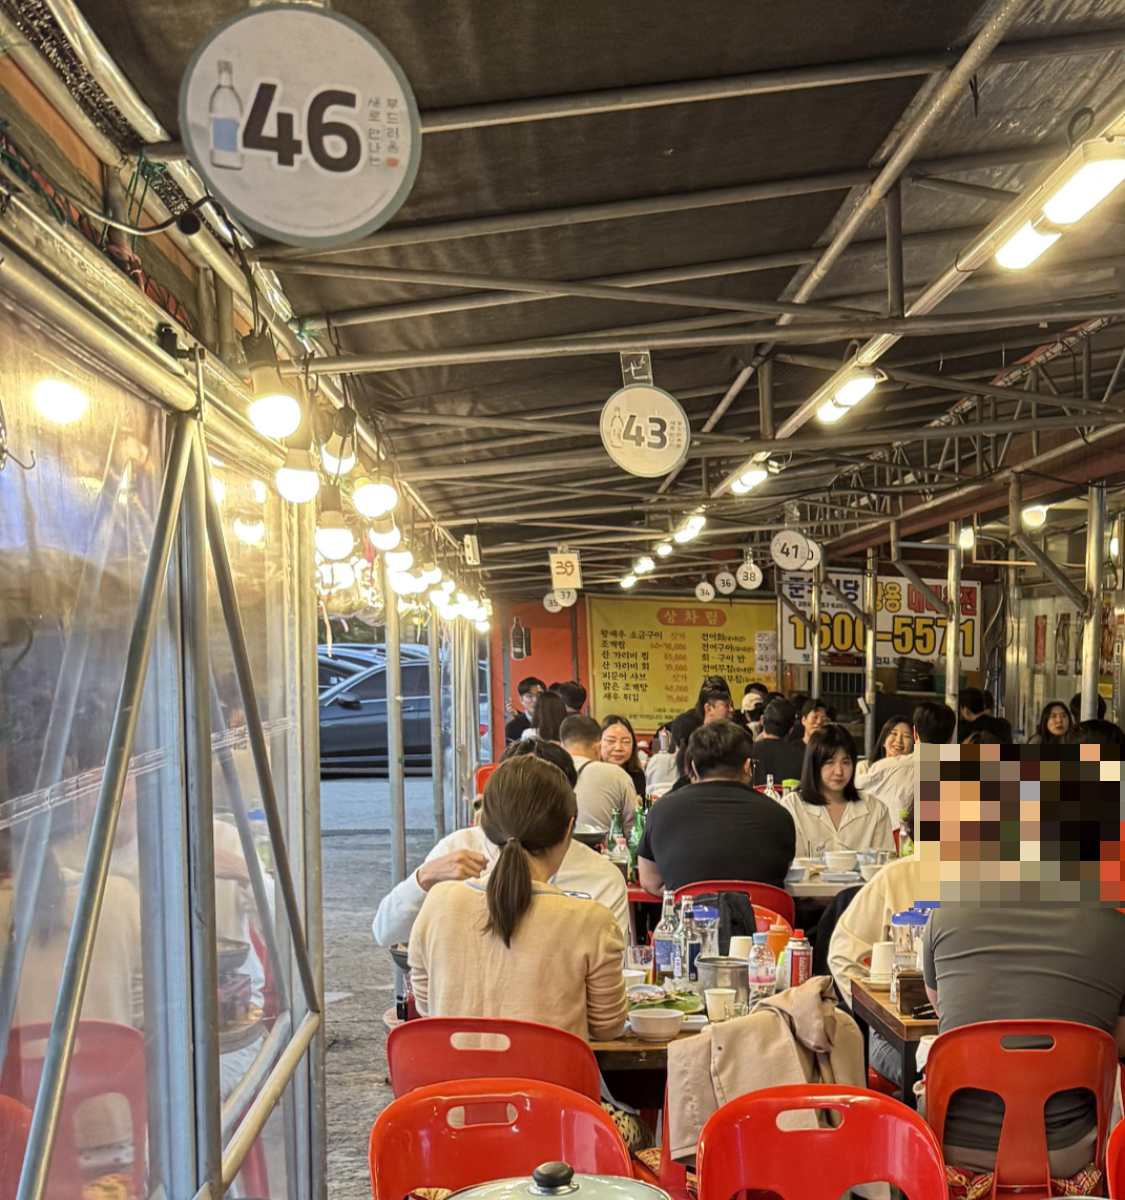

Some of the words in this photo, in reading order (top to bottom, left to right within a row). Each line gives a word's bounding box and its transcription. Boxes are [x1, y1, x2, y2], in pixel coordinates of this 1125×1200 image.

[242, 82, 362, 173] 46
[622, 414, 667, 450] 43
[780, 541, 799, 559] 41
[555, 560, 575, 576] 39
[742, 572, 756, 582] 38
[720, 578, 731, 588] 36
[559, 590, 572, 600] 37
[700, 588, 710, 597] 34
[629, 630, 663, 640] 소금구이
